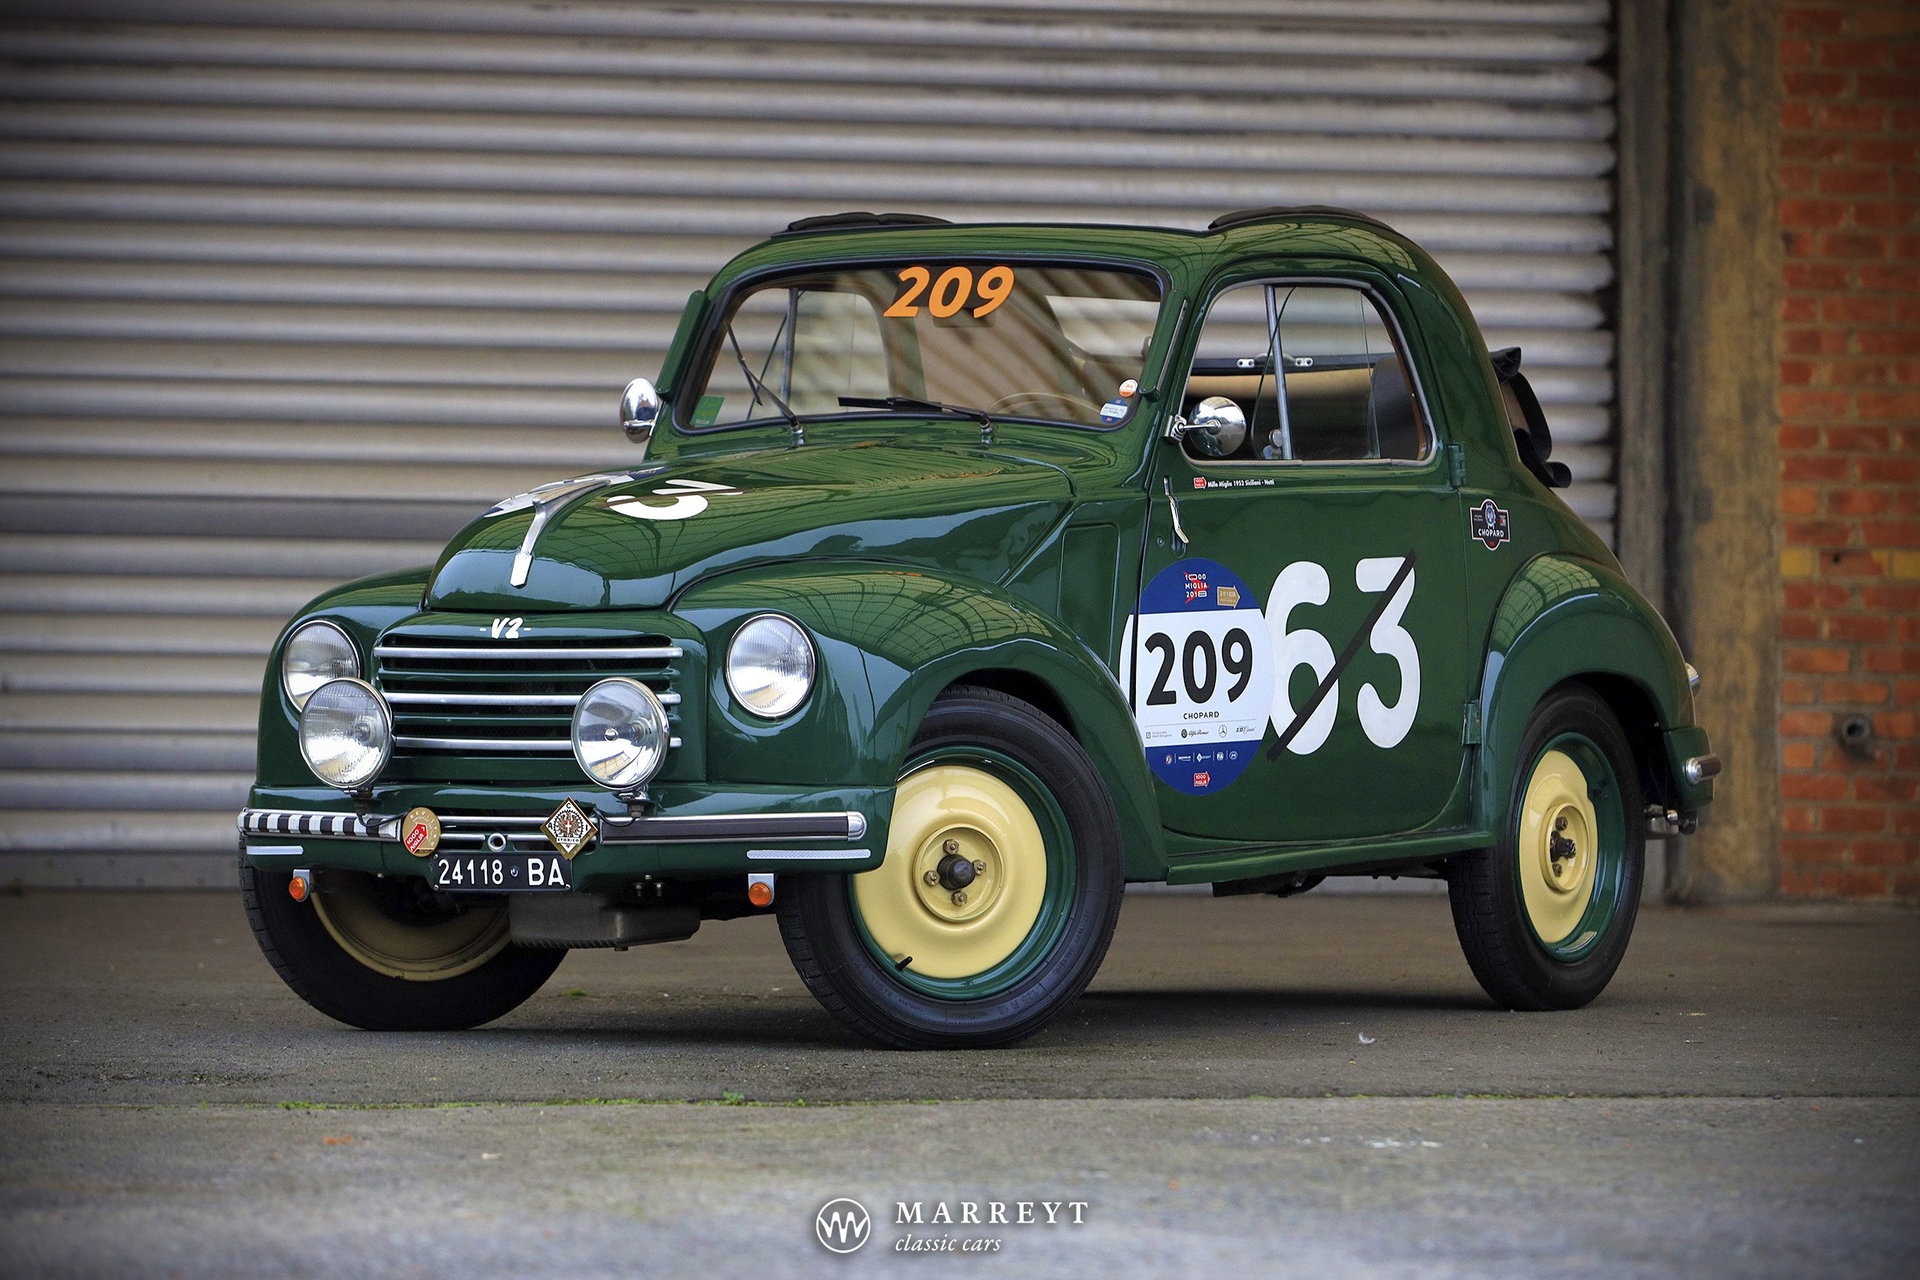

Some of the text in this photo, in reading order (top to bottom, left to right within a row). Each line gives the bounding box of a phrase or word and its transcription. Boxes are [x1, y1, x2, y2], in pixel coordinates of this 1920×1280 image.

[883, 266, 1015, 319] 209
[1478, 528, 1505, 538] CHOPARD
[1185, 573, 1207, 581] 1000
[1186, 590, 1208, 598] 2018
[1264, 556, 1421, 755] 63
[1144, 627, 1253, 706] 209
[1183, 711, 1220, 720] CHOPARD
[406, 829, 420, 845] 1000
[410, 833, 425, 851] MIGLIA
[438, 858, 565, 886] 24118 BA
